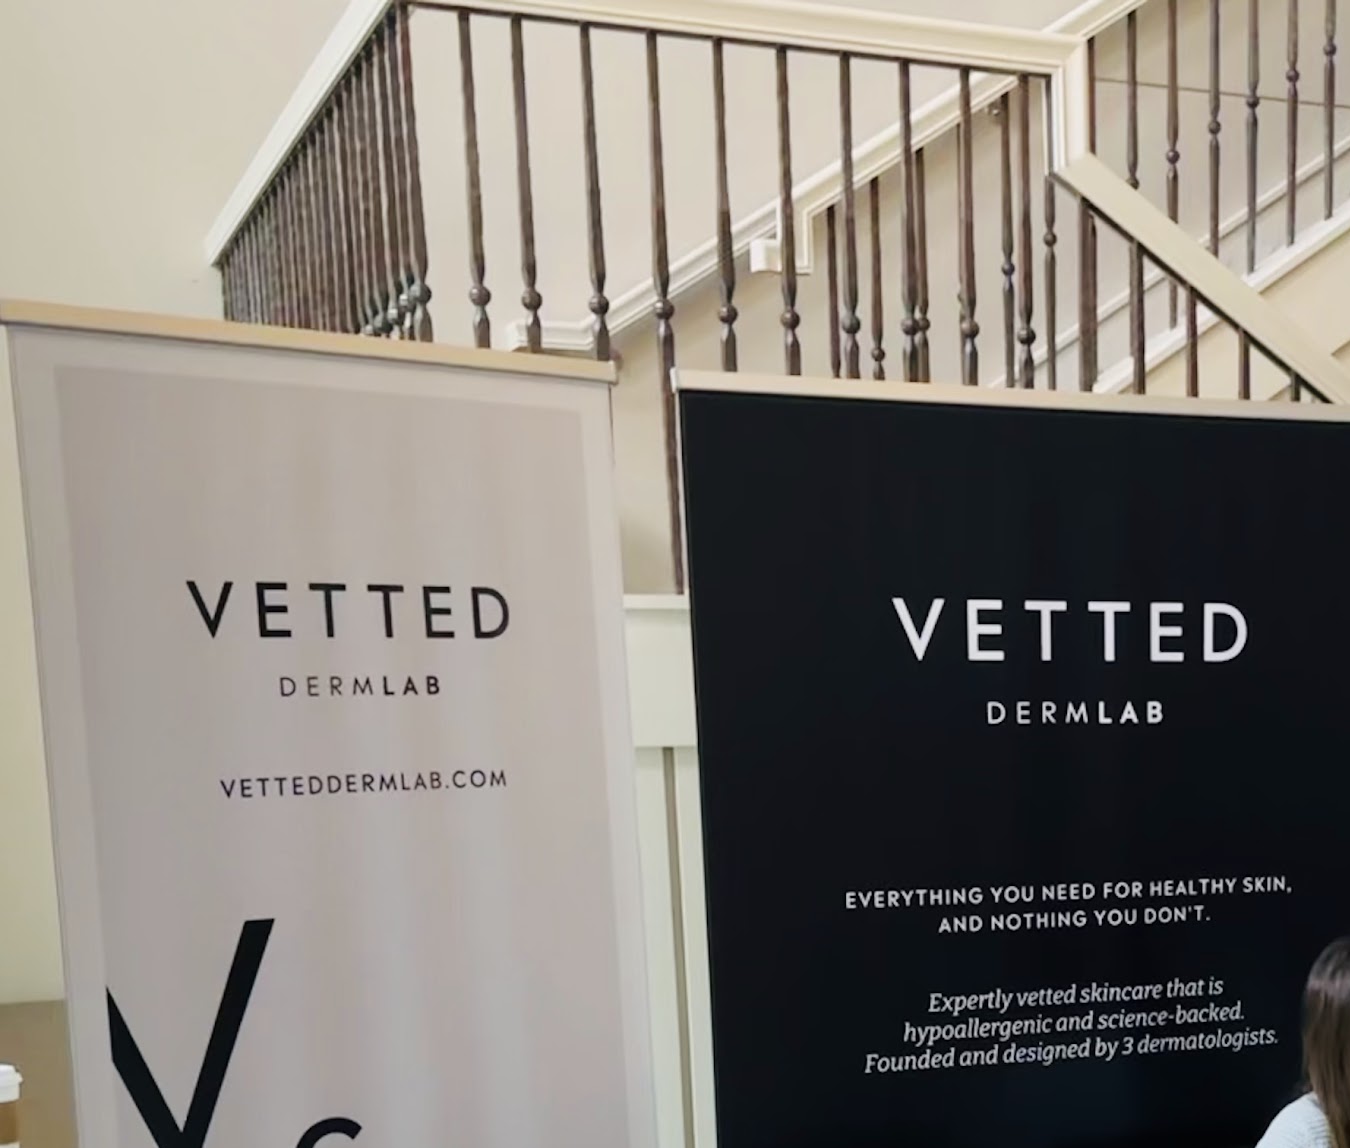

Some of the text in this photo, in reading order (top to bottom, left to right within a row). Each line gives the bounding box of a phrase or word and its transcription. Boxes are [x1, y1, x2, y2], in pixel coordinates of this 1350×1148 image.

[186, 581, 510, 638] VETTED
[892, 598, 1248, 662] VETTED
[280, 675, 440, 697] DERMLAB
[986, 700, 1163, 725] DERMLAB
[220, 769, 507, 799] VETTEDDERMLAB.COM
[845, 875, 1292, 909] EVERYTHING YOU NEED FOR HEALTHY SKIN,
[938, 904, 1211, 934] AND NOTHING YOU DON'T.
[928, 976, 1224, 1017] Expertly vetted skincare that is
[903, 1000, 1245, 1047] hypoallergenic and science-backed.
[864, 1026, 1278, 1074] Founded and designed by 3 dermatologists.
